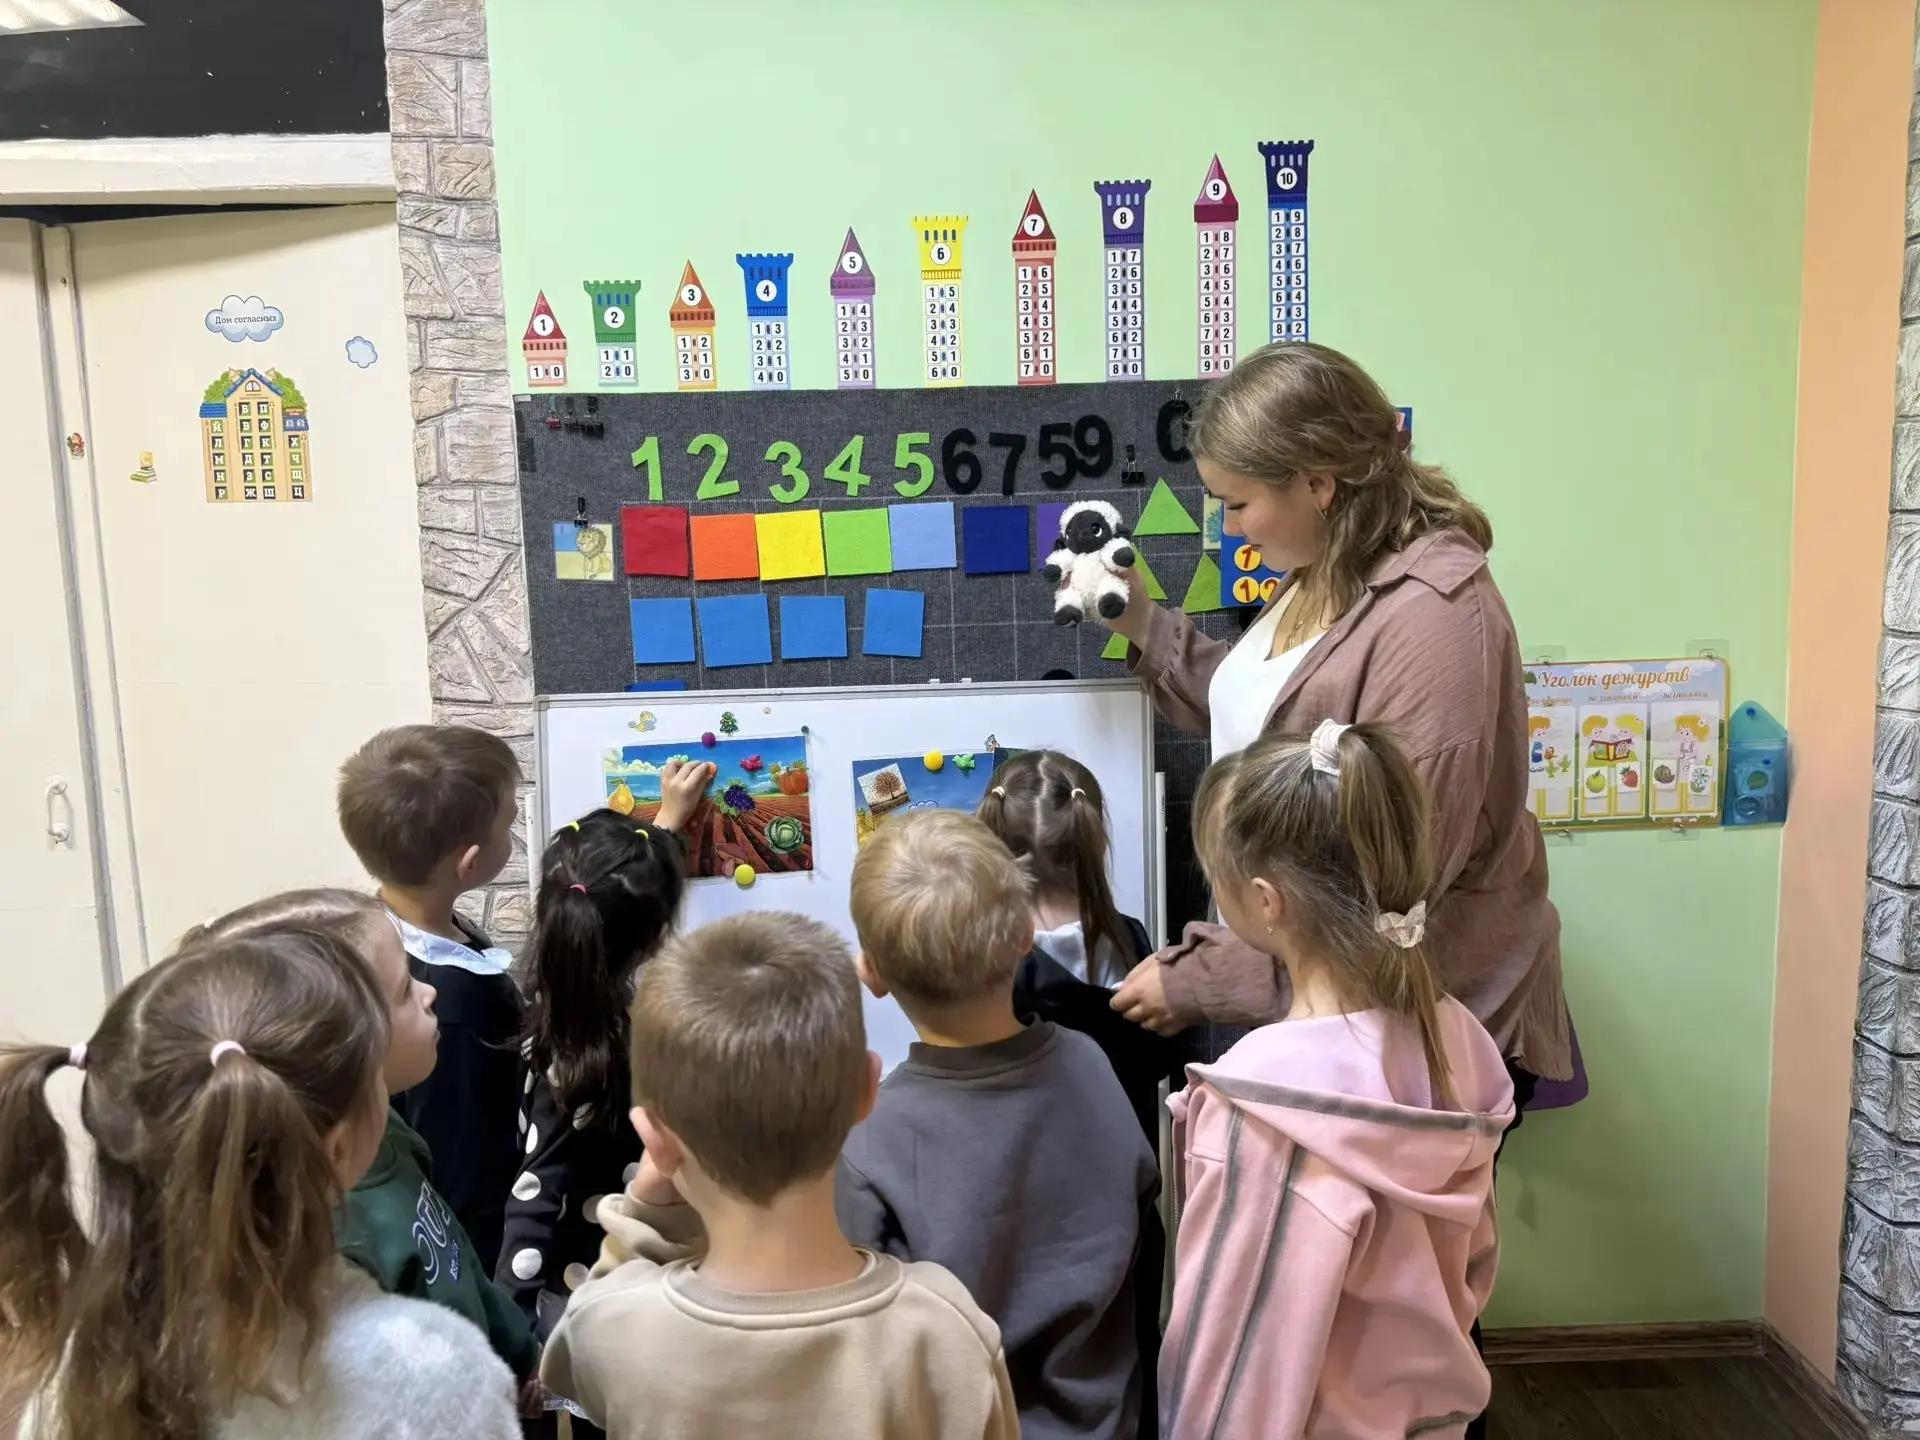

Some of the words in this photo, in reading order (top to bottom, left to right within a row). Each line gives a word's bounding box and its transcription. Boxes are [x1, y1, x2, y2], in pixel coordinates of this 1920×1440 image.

[1280, 172, 1293, 185] 10
[1212, 183, 1220, 196] 9
[1120, 212, 1127, 224] 8
[1275, 212, 1280, 222] 1
[1294, 211, 1301, 222] 9
[1031, 219, 1038, 232] 7
[1204, 232, 1208, 243] 1
[1223, 231, 1230, 242] 8
[1275, 228, 1282, 239] 2
[1294, 227, 1301, 238] 8
[937, 247, 944, 260] 6
[1204, 248, 1210, 259] 2
[1223, 248, 1229, 258] 7
[1276, 244, 1282, 255] 3
[1295, 243, 1301, 254] 7
[1112, 252, 1116, 262] 1
[1131, 250, 1137, 262] 7
[849, 256, 856, 269] 5
[1276, 260, 1282, 270] 4
[1295, 259, 1301, 270] 6
[1022, 268, 1027, 279] 1
[1041, 267, 1048, 278] 6
[1111, 268, 1118, 278] 2
[1131, 267, 1137, 278] 6
[1204, 264, 1210, 275] 3
[1224, 264, 1230, 274] 6
[1204, 281, 1210, 291] 4
[1223, 280, 1230, 290] 5
[1276, 276, 1282, 287] 5
[1295, 275, 1302, 286] 5
[688, 288, 695, 301] 3
[763, 284, 770, 297] 4
[930, 287, 934, 298] 1
[949, 286, 955, 297] 5
[1022, 284, 1028, 295] 2
[1042, 284, 1048, 294] 5
[1112, 284, 1118, 295] 3
[1131, 283, 1137, 294] 5
[1204, 296, 1210, 307] 5
[1224, 296, 1230, 306] 4
[1276, 292, 1282, 303] 6
[1295, 291, 1301, 302] 4
[841, 306, 846, 316] 1
[860, 305, 866, 316] 4
[930, 303, 936, 314] 2
[949, 302, 956, 313] 4
[1023, 300, 1029, 311] 3
[1042, 300, 1048, 310] 4
[1112, 300, 1118, 311] 4
[1131, 300, 1137, 310] 4
[611, 311, 618, 324] 2
[1204, 312, 1210, 324] 6
[1223, 312, 1230, 322] 3
[1276, 308, 1282, 318] 7
[1295, 307, 1302, 318] 3
[215, 316, 232, 324] Дом
[234, 315, 278, 324] согласных
[540, 319, 546, 331] 1
[930, 319, 937, 330] 3
[950, 318, 956, 330] 3
[1023, 316, 1029, 327] 4
[1042, 316, 1048, 326] 3
[1112, 316, 1119, 327] 5
[1131, 316, 1138, 326] 3
[756, 324, 760, 334] 1
[775, 324, 781, 334] 3
[841, 321, 848, 332] 2
[861, 321, 867, 332] 3
[1276, 324, 1282, 334] 8
[1296, 322, 1302, 334] 2
[1024, 332, 1030, 343] 5
[1042, 332, 1049, 342] 2
[1112, 332, 1118, 343] 6
[1131, 331, 1138, 342] 2
[1204, 328, 1210, 340] 7
[1224, 328, 1230, 338] 2
[681, 337, 686, 348] 1
[701, 336, 708, 348] 2
[756, 340, 762, 350] 2
[776, 340, 782, 350] 2
[842, 337, 849, 348] 3
[862, 337, 868, 348] 2
[930, 335, 937, 346] 4
[950, 334, 956, 345] 2
[604, 350, 609, 360] 1
[624, 350, 629, 360] 1
[1024, 348, 1030, 359] 6
[1043, 348, 1048, 358] 1
[1112, 348, 1118, 358] 7
[1132, 347, 1137, 358] 1
[1204, 344, 1210, 355] 8
[1224, 344, 1228, 354] 1
[682, 353, 689, 364] 2
[702, 353, 708, 363] 1
[757, 356, 764, 366] 3
[776, 356, 782, 366] 1
[843, 354, 849, 364] 4
[862, 353, 868, 364] 1
[932, 351, 938, 362] 5
[951, 351, 956, 361] 1
[604, 366, 611, 376] 2
[624, 366, 631, 376] 0
[1024, 364, 1030, 375] 7
[1043, 364, 1050, 374] 0
[1113, 364, 1119, 374] 8
[1132, 363, 1138, 374] 0
[1204, 360, 1210, 371] 9
[1224, 360, 1230, 370] 0
[534, 367, 539, 377] 1
[554, 366, 560, 377] 0
[684, 369, 690, 380] 3
[704, 368, 710, 379] 0
[758, 372, 764, 382] 4
[777, 372, 784, 382] 0
[844, 369, 850, 380] 5
[863, 369, 869, 380] 0
[932, 367, 938, 378] 6
[951, 366, 957, 377] 0
[631, 436, 663, 501] 1
[686, 433, 740, 500] 2
[764, 441, 811, 504] 3
[823, 435, 871, 497] 4
[893, 432, 934, 498] 5
[942, 428, 982, 495] 6
[989, 432, 1027, 496] 7
[1073, 415, 1113, 478] 9
[1240, 579, 1250, 601] 1
[1538, 671, 1597, 688] Уголок
[1601, 667, 1690, 690] дежурств
